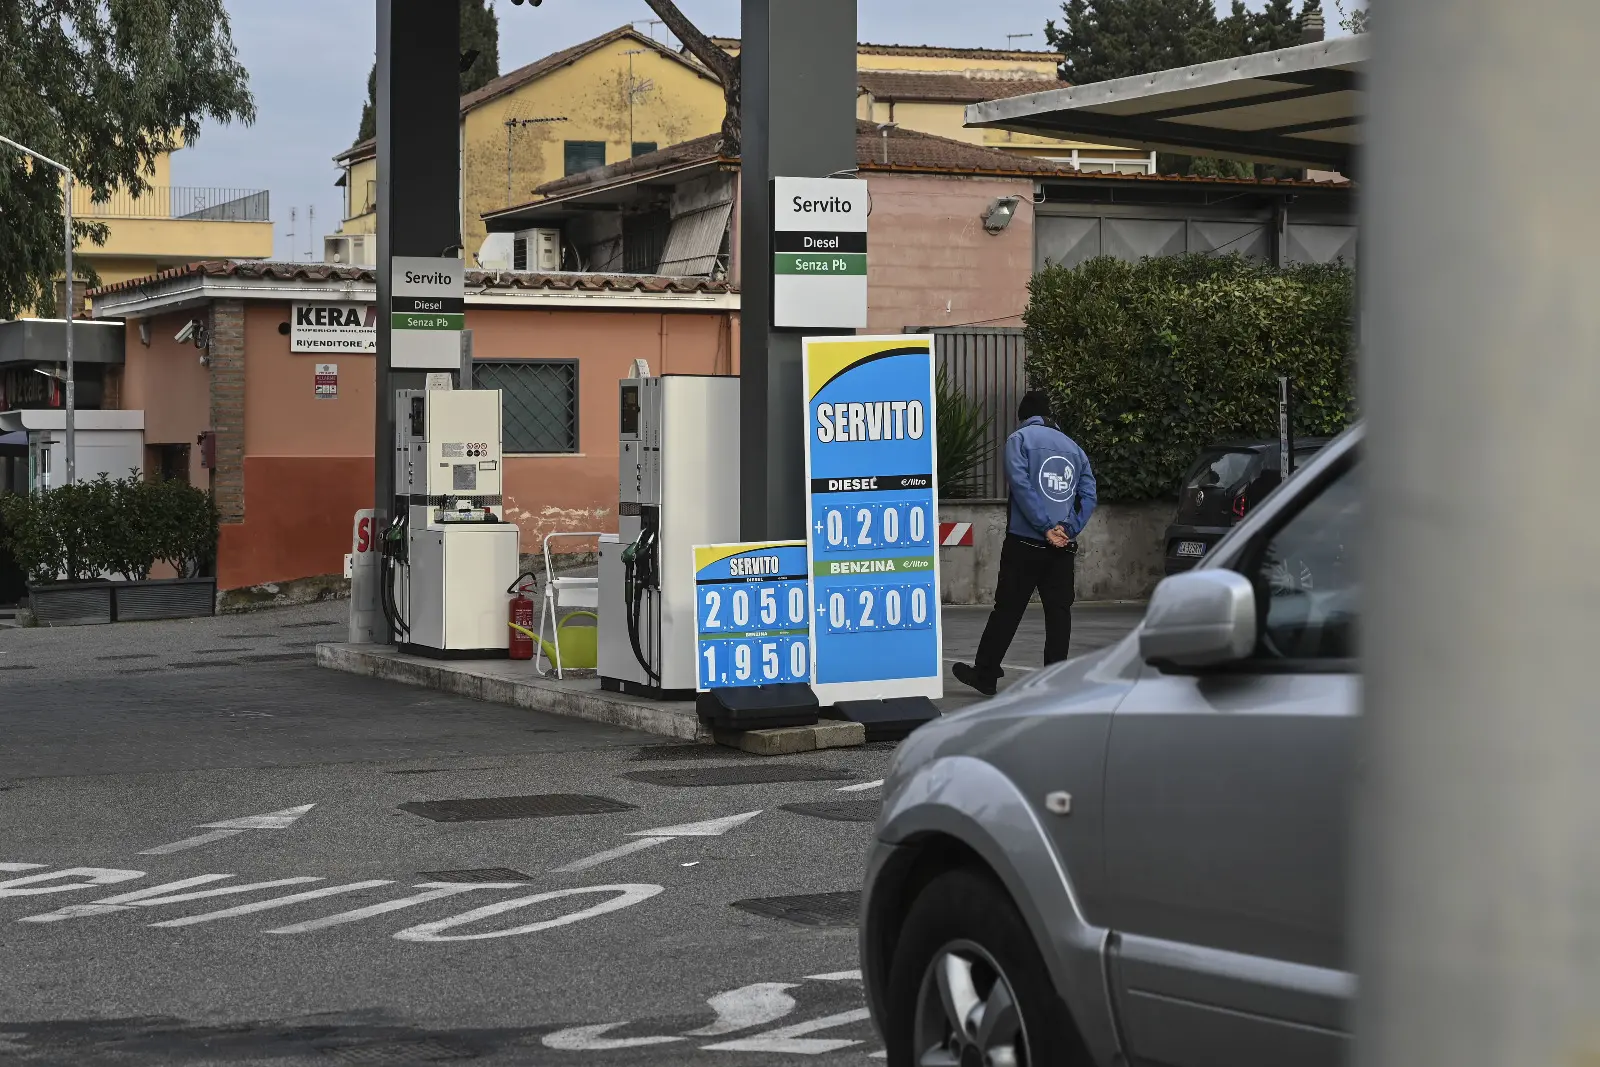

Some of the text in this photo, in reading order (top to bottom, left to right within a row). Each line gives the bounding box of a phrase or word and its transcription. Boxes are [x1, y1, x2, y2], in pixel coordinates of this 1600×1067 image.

[793, 195, 852, 213] Servito
[803, 236, 839, 248] Diesel
[795, 258, 847, 271] Senza Pb
[405, 271, 452, 285] Servito
[414, 300, 442, 310] Diesel
[407, 317, 449, 327] Senza Pb
[296, 339, 363, 348] RIVENDITORE
[816, 399, 924, 443] SERVITO
[828, 478, 878, 491] DIESEL
[729, 555, 780, 576] SERVITO
[830, 559, 896, 574] BENZINA
[705, 587, 804, 628] 2050
[703, 641, 806, 683] 1,950
